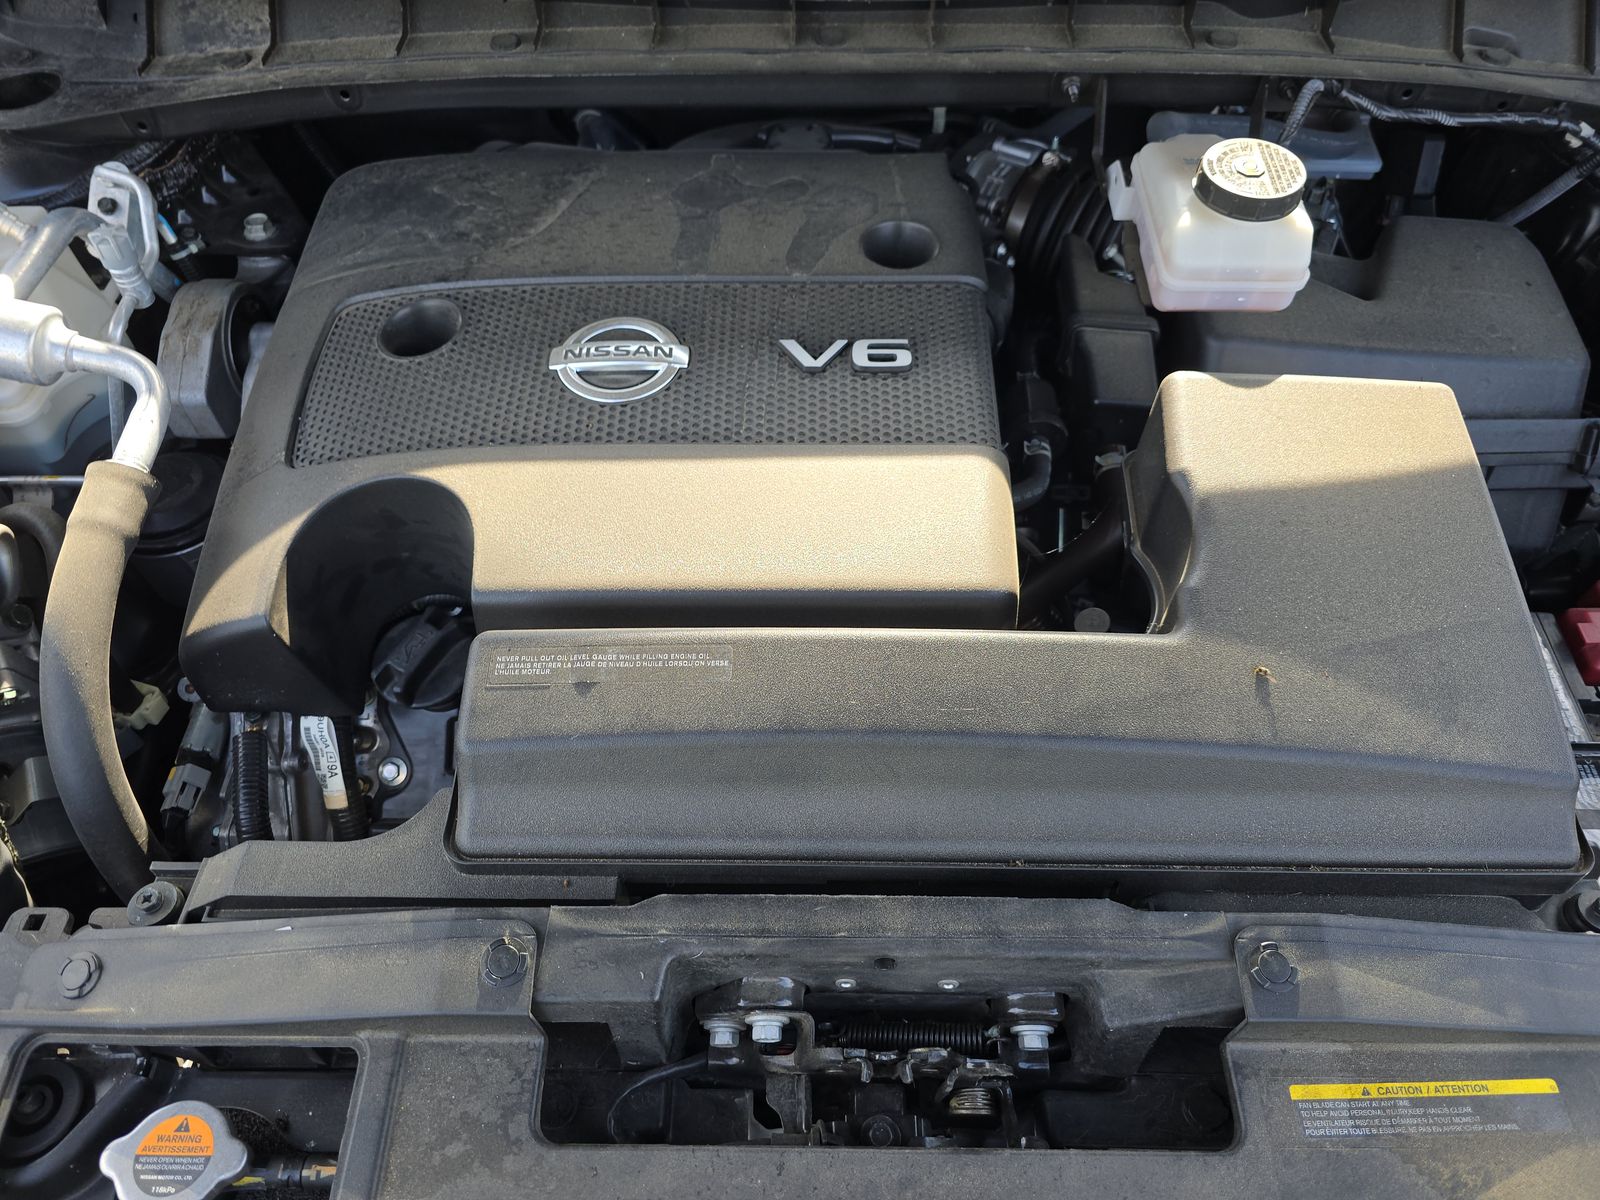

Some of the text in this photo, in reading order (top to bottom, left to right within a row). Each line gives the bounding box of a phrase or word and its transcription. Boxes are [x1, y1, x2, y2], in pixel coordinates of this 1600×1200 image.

[563, 345, 674, 360] NISSAN
[778, 338, 913, 374] V6
[533, 661, 561, 669] RETIRER
[573, 660, 596, 668] JAUGE
[1377, 1086, 1423, 1096] CAUTION
[1434, 1084, 1489, 1094] ATTENTION
[1335, 1101, 1349, 1109] CAN
[1312, 1109, 1328, 1117] HELP
[1330, 1109, 1349, 1117] AVOID
[1408, 1107, 1424, 1115] KEEP
[1426, 1106, 1449, 1114] HANDS
[1303, 1120, 1312, 1128] LE
[1312, 1119, 1355, 1127] VENTILATEUR
[1356, 1118, 1381, 1126] RISQUE
[1434, 1116, 1451, 1124] TOUT
[1349, 1127, 1372, 1135] TOUTE
[156, 1134, 203, 1143] WARNING
[141, 1145, 211, 1154] AVERTISSEMENT
